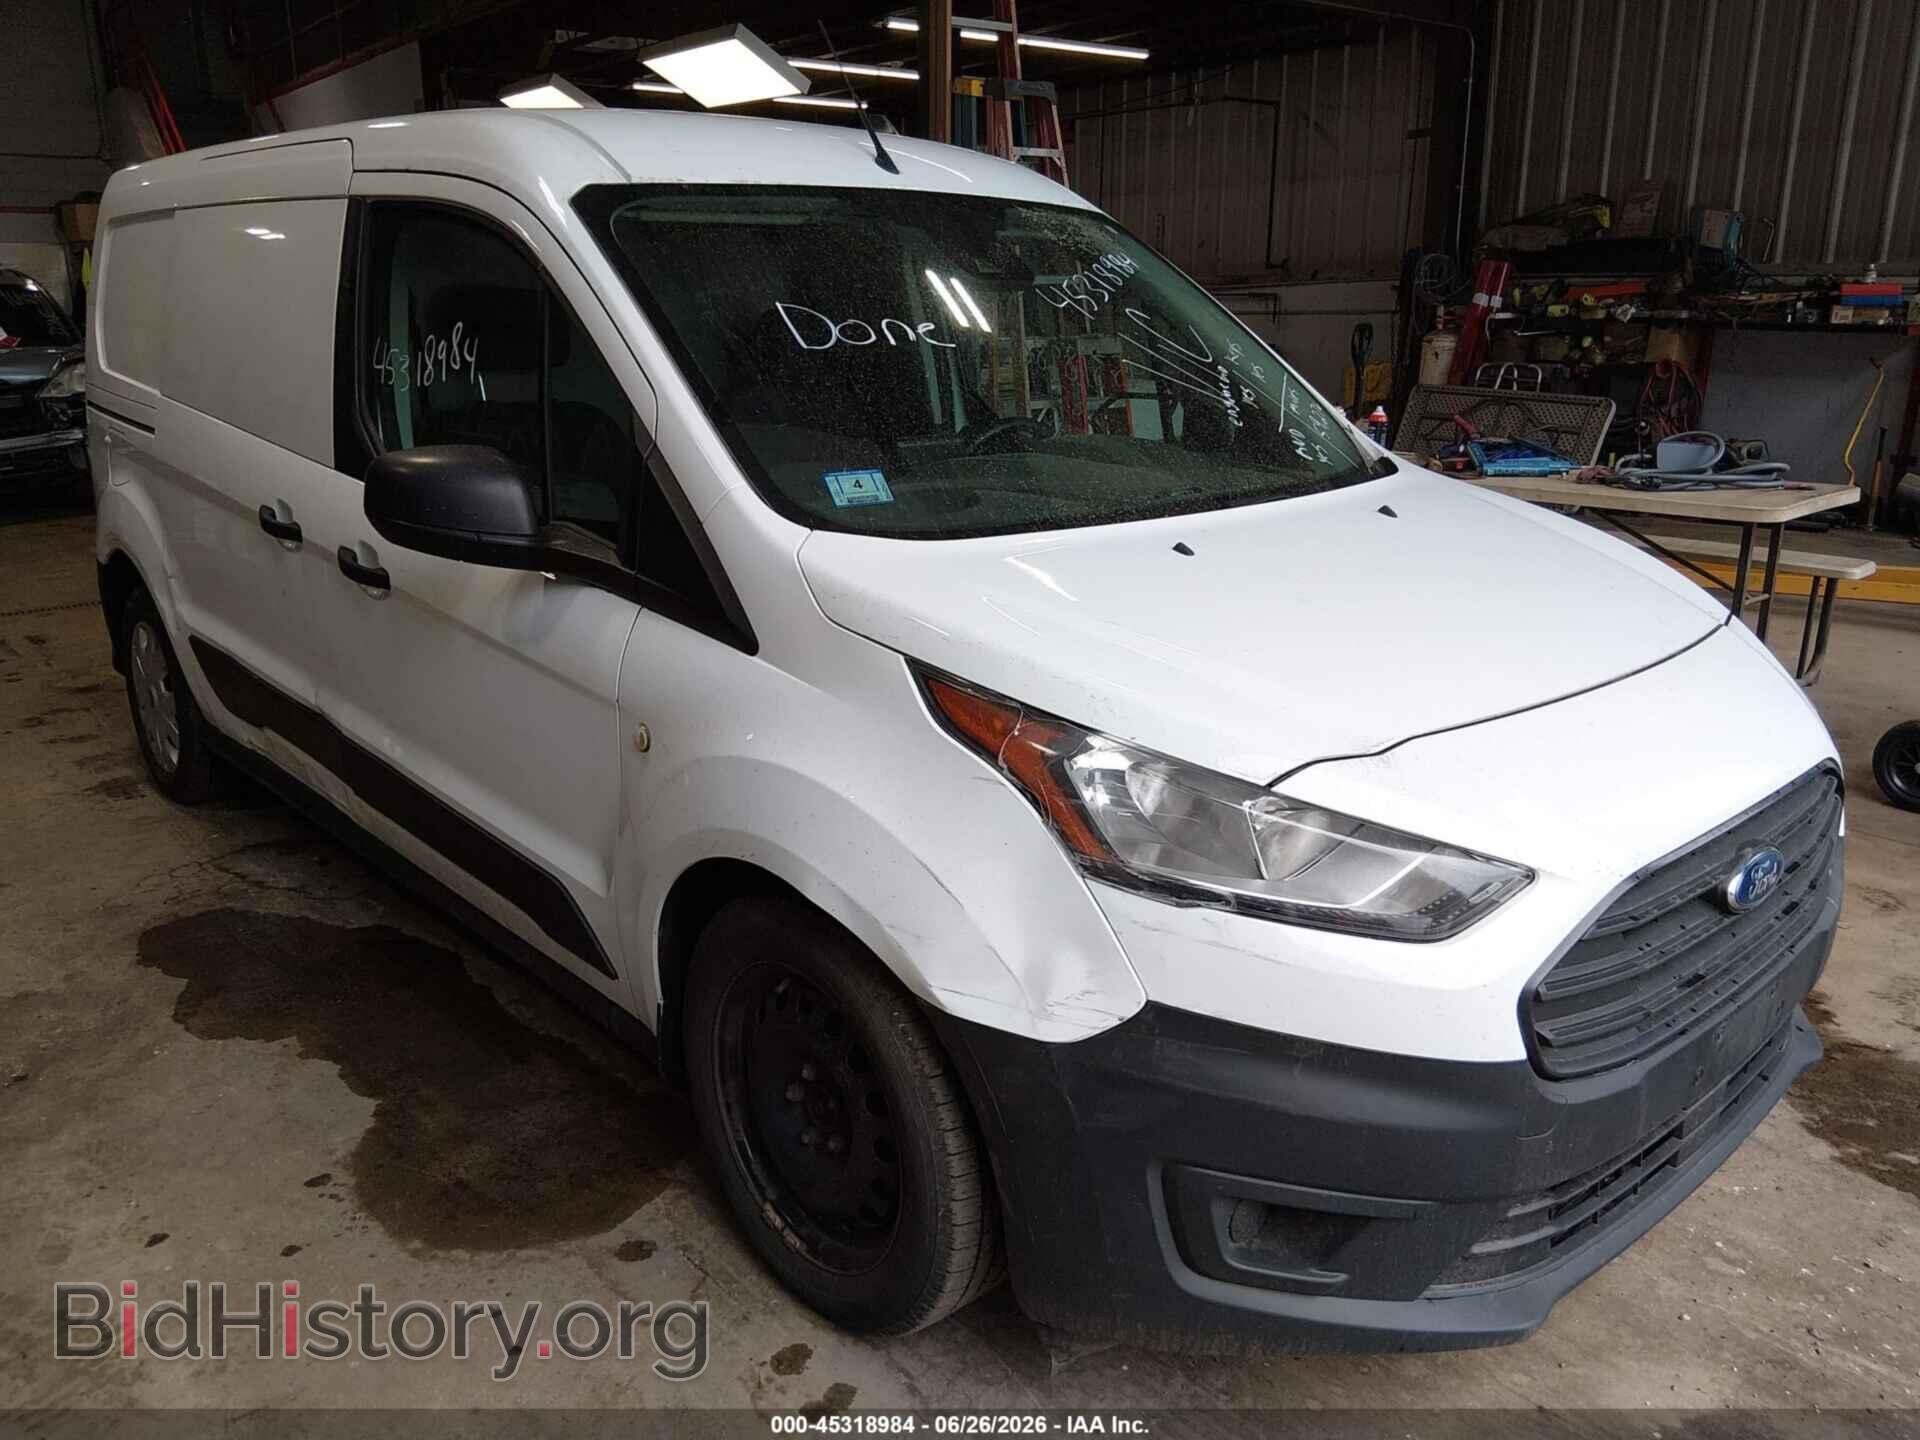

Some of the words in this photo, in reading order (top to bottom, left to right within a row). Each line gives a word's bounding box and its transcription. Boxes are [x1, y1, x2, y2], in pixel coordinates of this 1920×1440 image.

[775, 301, 956, 350] Done
[372, 321, 480, 392] 45318984
[853, 479, 863, 489] 4
